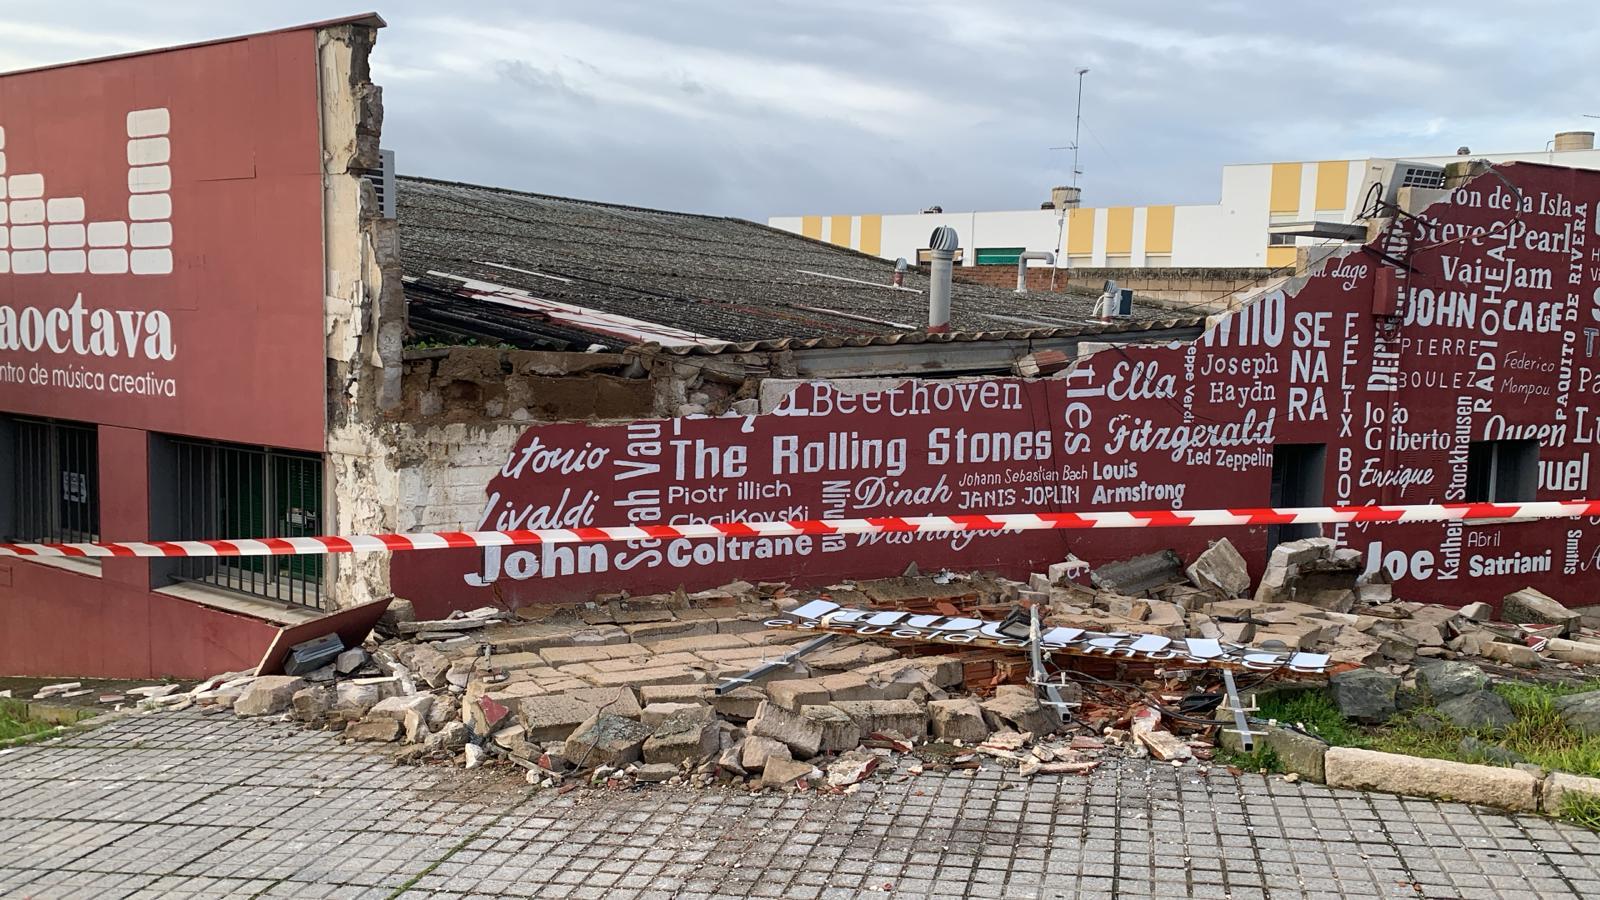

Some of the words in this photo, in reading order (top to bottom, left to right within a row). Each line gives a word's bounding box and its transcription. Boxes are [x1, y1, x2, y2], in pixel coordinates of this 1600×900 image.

[1488, 186, 1512, 210] de
[1538, 192, 1572, 218] Isla
[1507, 220, 1571, 253] Pearl
[1568, 202, 1588, 285] RIVERA
[1440, 255, 1482, 284] Vai
[1503, 258, 1553, 293] Jam
[1403, 286, 1478, 329] JOHN
[1502, 299, 1564, 333] CAGE
[1473, 221, 1508, 413] RADIOHEAD
[1565, 293, 1580, 322] DE
[1292, 311, 1333, 348] SE
[1401, 337, 1479, 357] PIERRE
[1201, 352, 1279, 379] Joseph
[1290, 350, 1329, 383] NA
[1503, 350, 1555, 372] Federico
[1555, 330, 1576, 421] PAQUITO
[29, 363, 48, 386] de
[52, 364, 104, 391] música
[109, 371, 176, 397] creativa
[1107, 360, 1178, 402] Ella
[1209, 381, 1276, 408] Haydn
[1398, 370, 1477, 389] BOULEZ
[1500, 377, 1551, 404] Mompou
[809, 380, 1023, 417] Beethoven
[1183, 384, 1196, 424] Verdi
[1288, 386, 1329, 421] RA
[1104, 407, 1277, 463] Fitzgerald
[1445, 396, 1473, 500] Stockhausen
[1484, 415, 1567, 448] Queen
[668, 438, 748, 481] The
[772, 431, 907, 476] Rolling
[928, 426, 1052, 465] Stones
[1093, 459, 1139, 480] Louis
[1186, 449, 1211, 466] Led
[1215, 448, 1273, 471] Zeppelin
[853, 475, 953, 510] Dinah
[959, 472, 1001, 487] Johann
[1004, 465, 1059, 484] Sebastian
[1062, 464, 1088, 481] Bach
[1359, 457, 1435, 498] Enrique
[668, 485, 729, 505] Piotr
[958, 488, 1017, 510] JANIS
[1091, 480, 1185, 510] Armstrong
[1334, 447, 1353, 546] BOE
[613, 489, 663, 571] Saah
[821, 480, 851, 553] Nirvna
[1467, 531, 1501, 548] Abril
[1563, 529, 1583, 575] Smiths
[463, 543, 609, 587] John
[667, 534, 813, 568] Coltrane
[1356, 541, 1435, 584] Joe
[1469, 550, 1552, 578] Satriani
